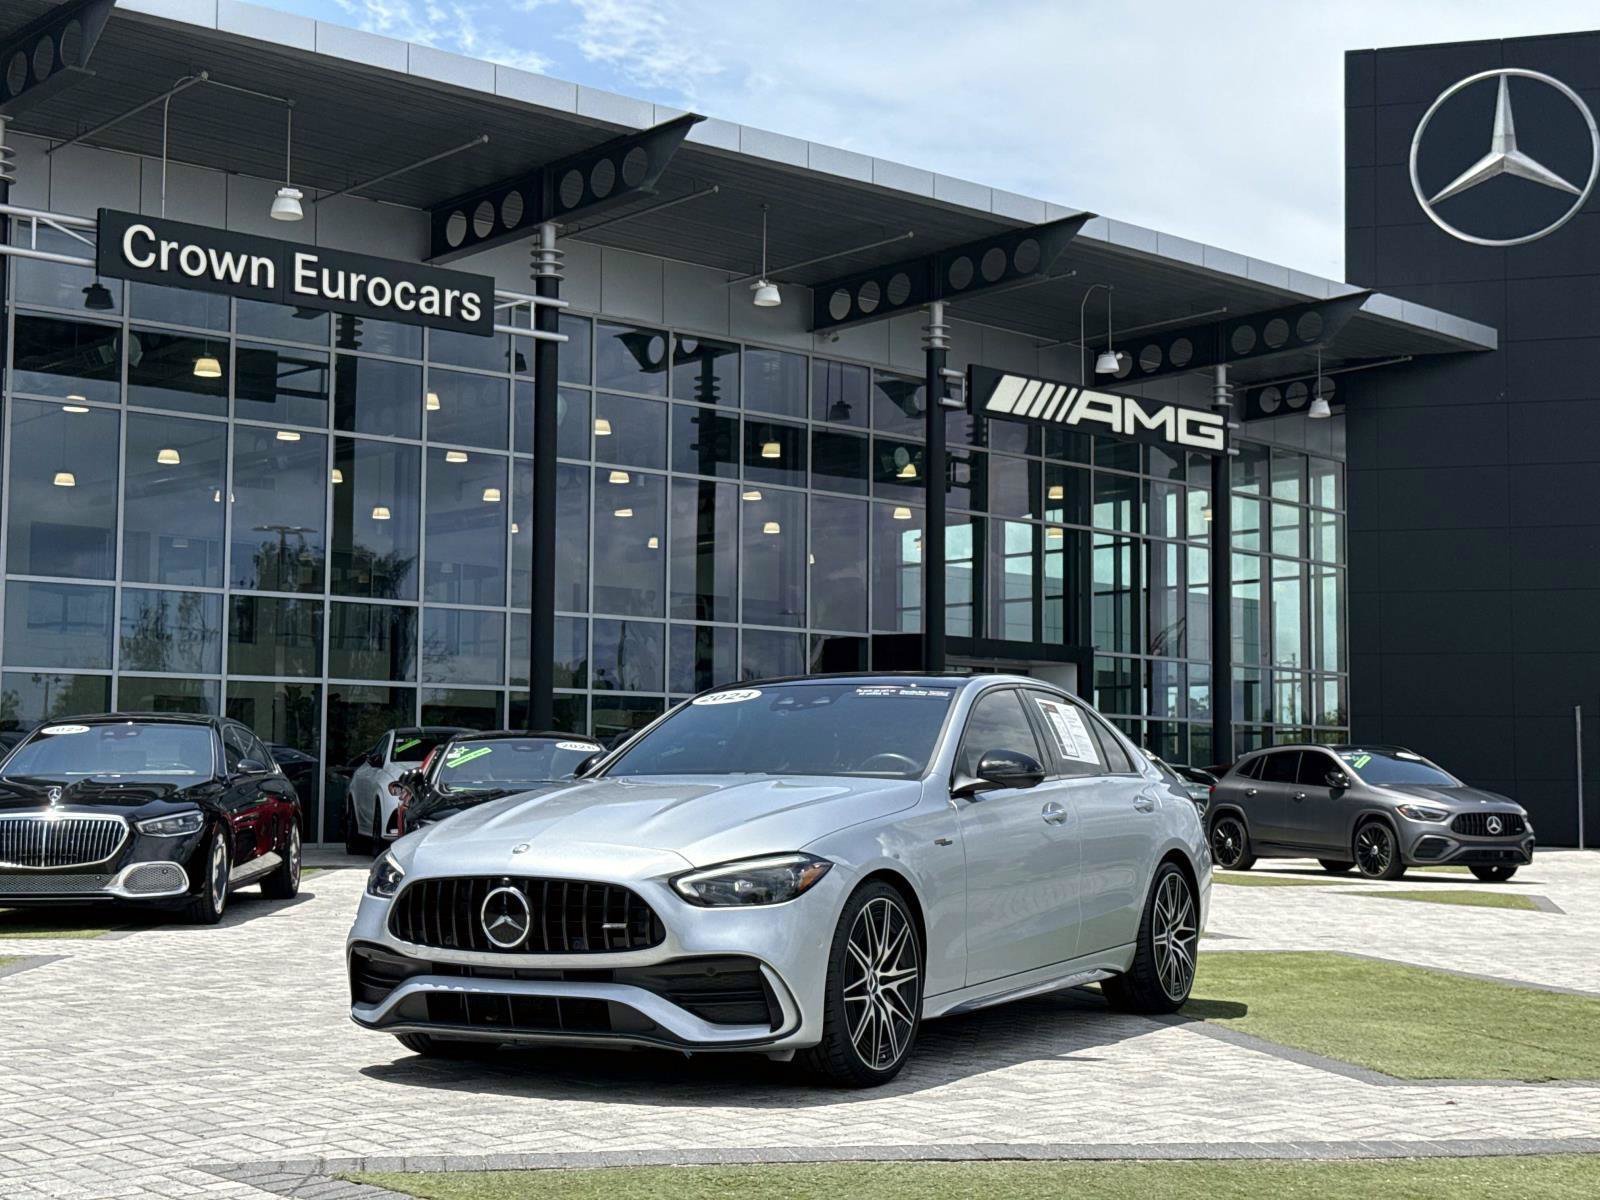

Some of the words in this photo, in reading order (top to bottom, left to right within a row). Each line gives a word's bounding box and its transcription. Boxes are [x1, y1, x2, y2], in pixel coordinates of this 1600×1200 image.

[122, 223, 275, 289] Crown
[293, 251, 482, 322] Eurocars
[1065, 388, 1224, 450] AMG
[699, 691, 755, 703] 2024
